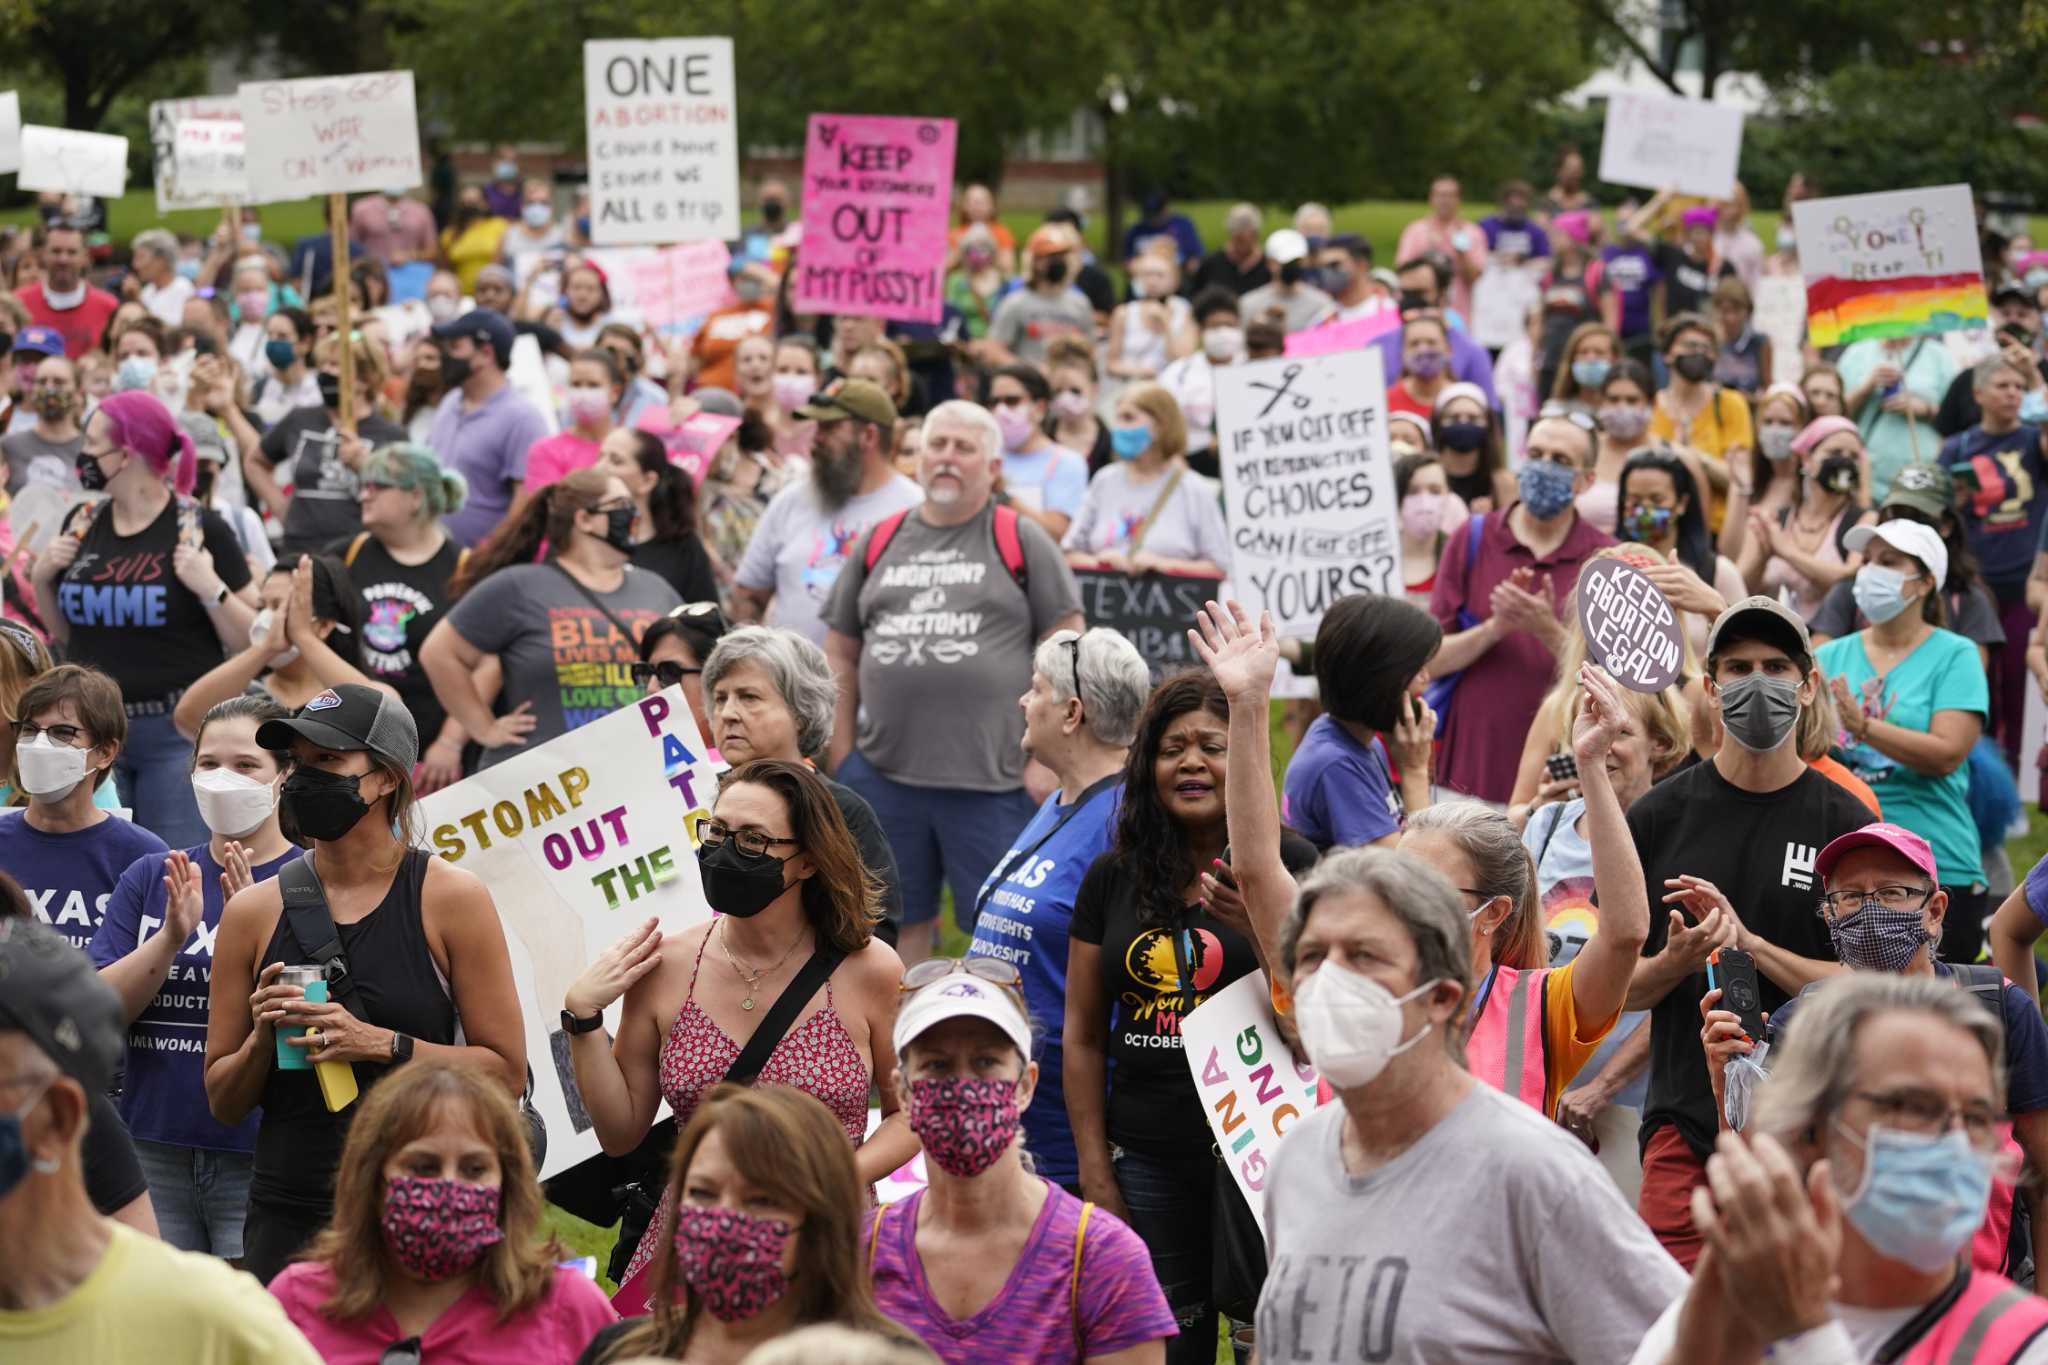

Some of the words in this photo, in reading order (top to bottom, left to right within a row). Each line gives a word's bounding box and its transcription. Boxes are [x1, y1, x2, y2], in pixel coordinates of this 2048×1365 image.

[606, 55, 712, 97] ONE
[593, 104, 728, 127] ABORTION
[840, 141, 914, 172] KEEP
[832, 202, 912, 244] OUT
[804, 264, 846, 299] MY
[848, 266, 942, 307] PUSSY!
[1234, 429, 1253, 453] IF
[1259, 421, 1295, 447] YOU
[1299, 411, 1334, 442] CUT
[1338, 407, 1375, 438] OFF
[1236, 460, 1261, 484] MY
[1244, 472, 1373, 519] CHOICES
[1235, 527, 1284, 553] CAN
[91, 552, 167, 583] SUIS
[880, 562, 987, 589] ABORTION?
[1250, 555, 1395, 621] YOURS?
[1073, 576, 1201, 622] TEXAS
[1610, 566, 1673, 626] KEEP
[1585, 570, 1679, 674] ABORTION
[1586, 601, 1660, 685] LEGAL
[560, 688, 617, 707] LOVE
[432, 767, 591, 863] STOMP
[543, 805, 630, 871] OUT
[591, 845, 677, 911] THE
